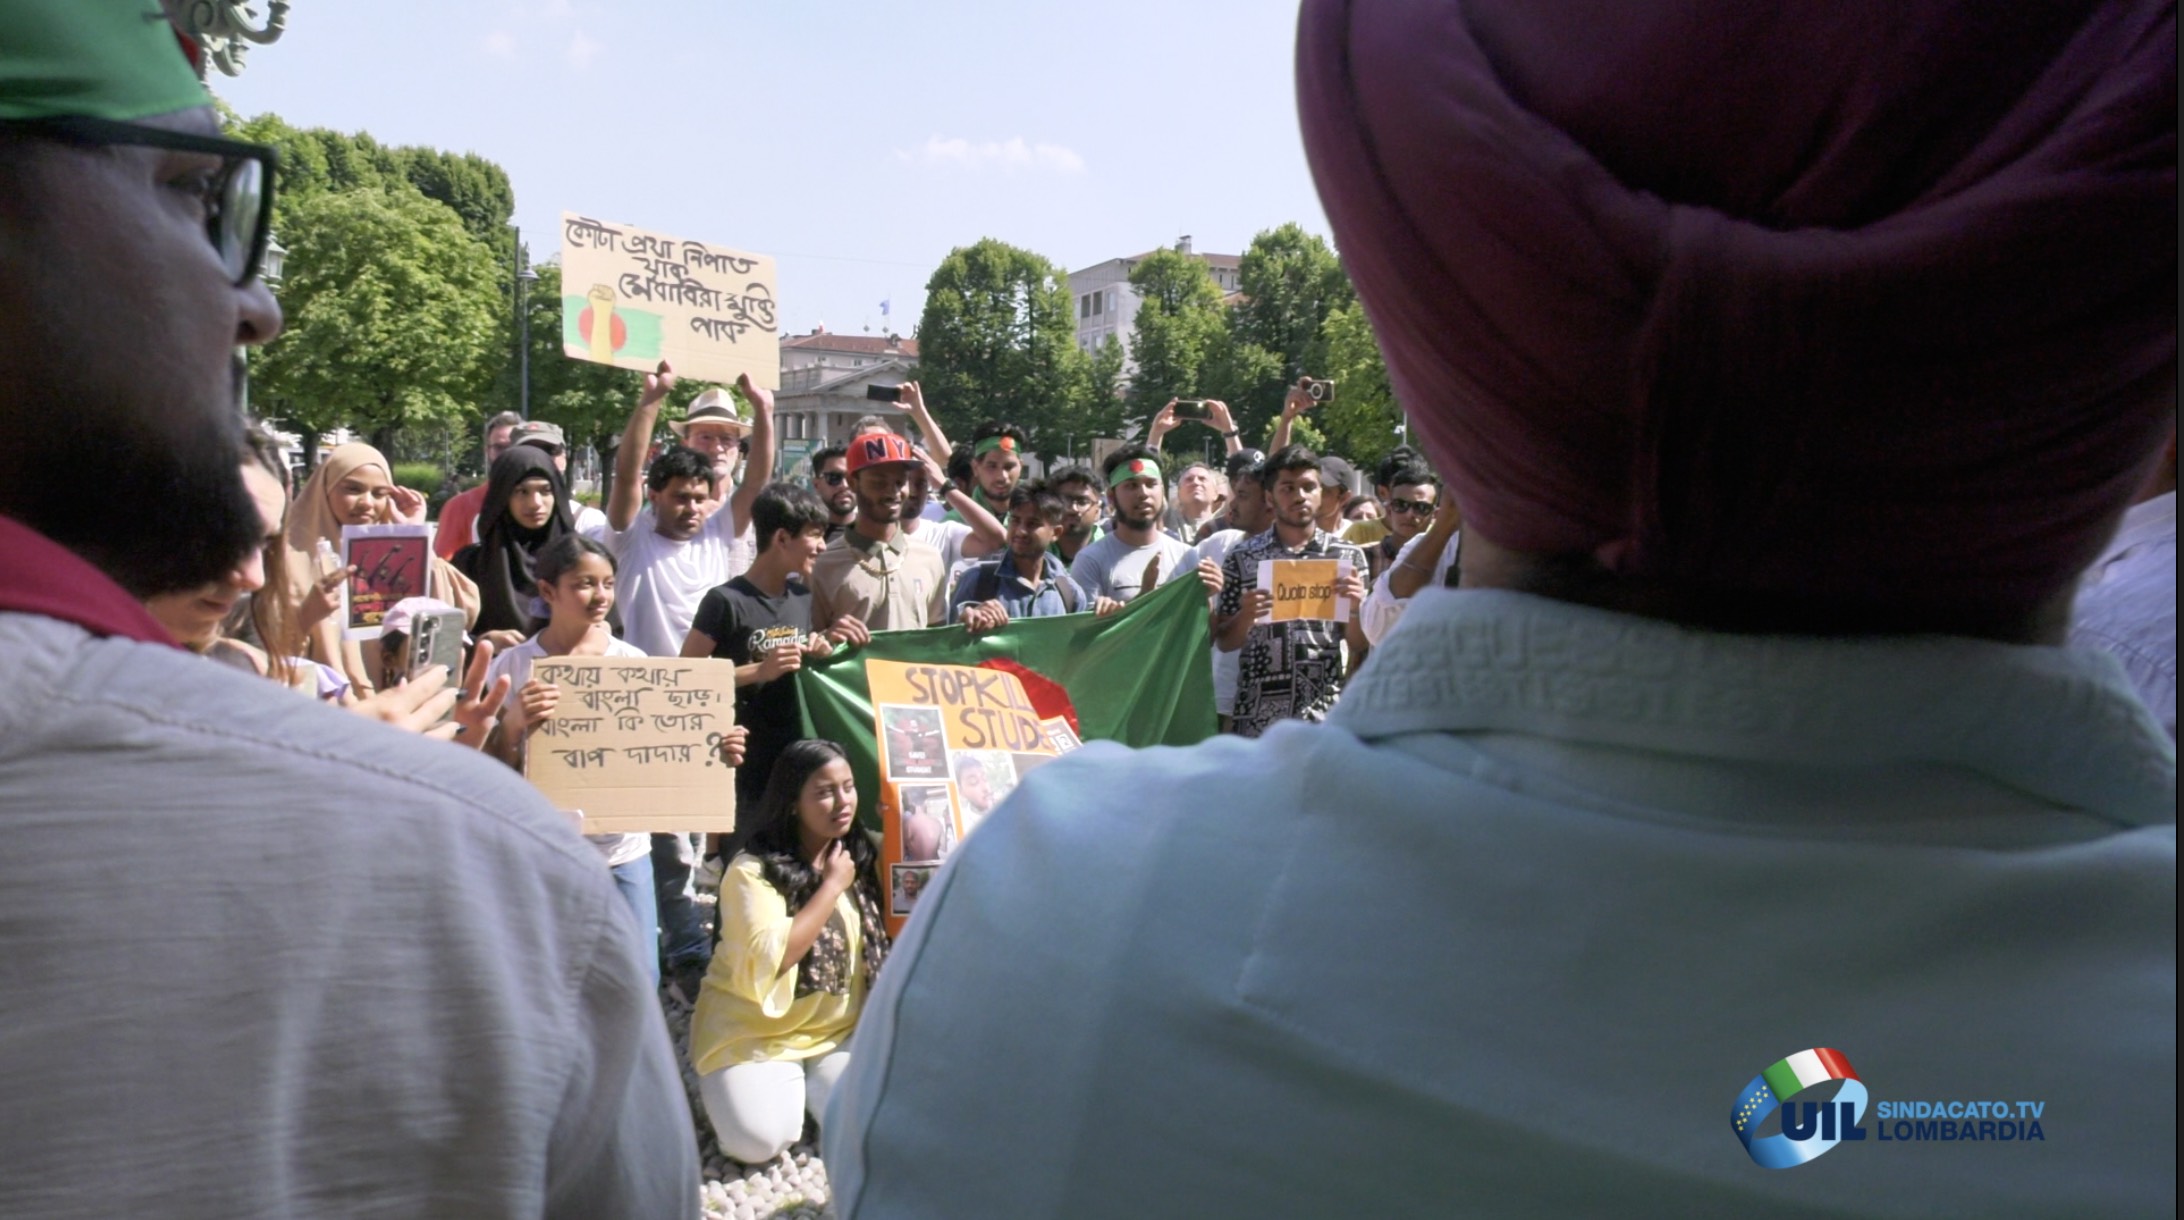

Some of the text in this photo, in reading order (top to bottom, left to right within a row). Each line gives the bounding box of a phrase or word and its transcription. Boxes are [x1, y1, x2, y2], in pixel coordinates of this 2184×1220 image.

[682, 241, 758, 274] নিপাত
[1277, 583, 1331, 602] Quota stop
[575, 687, 653, 712] বাংলা
[614, 706, 644, 731] কি
[651, 713, 715, 734] তোর
[551, 748, 617, 768] বাপ
